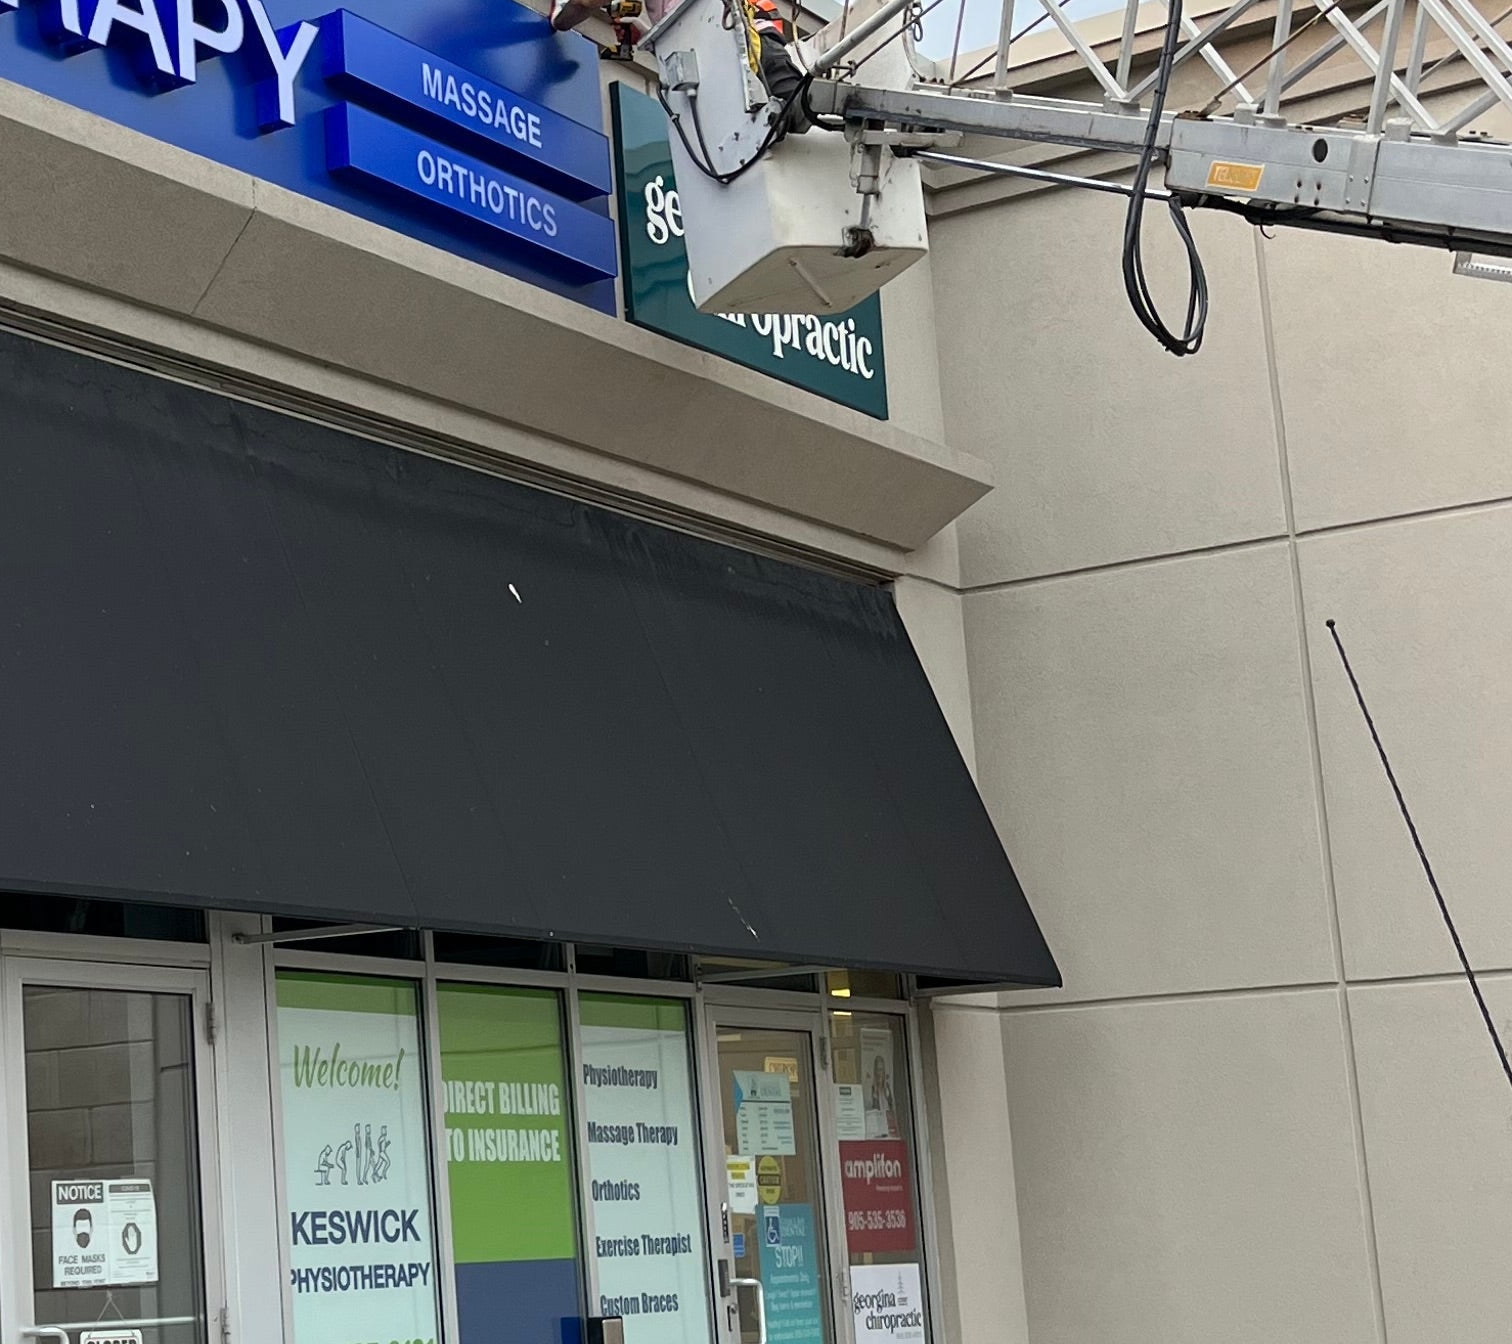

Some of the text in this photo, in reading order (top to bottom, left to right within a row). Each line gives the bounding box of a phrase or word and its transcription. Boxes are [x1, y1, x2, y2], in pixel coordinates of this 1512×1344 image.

[420, 62, 543, 149] MASSAGE
[416, 150, 558, 237] ORTHOTICS
[292, 1042, 405, 1091] Welcome!
[583, 1063, 658, 1089] Physiotherapy
[499, 1082, 561, 1116] BILLING
[468, 1128, 561, 1162] INSURANCE
[587, 1122, 678, 1146] Massage Therapy
[58, 1184, 102, 1201] NOTICE
[591, 1179, 640, 1201] Orthotics
[291, 1209, 421, 1246] KESWICK
[596, 1233, 692, 1258] Exercise Therapist
[58, 1253, 106, 1265] FACE MASKS
[64, 1265, 102, 1276] REQUIRED
[600, 1293, 679, 1317] Custom Braces
[853, 1288, 896, 1313] georgina
[865, 1307, 922, 1333] chiropractic
